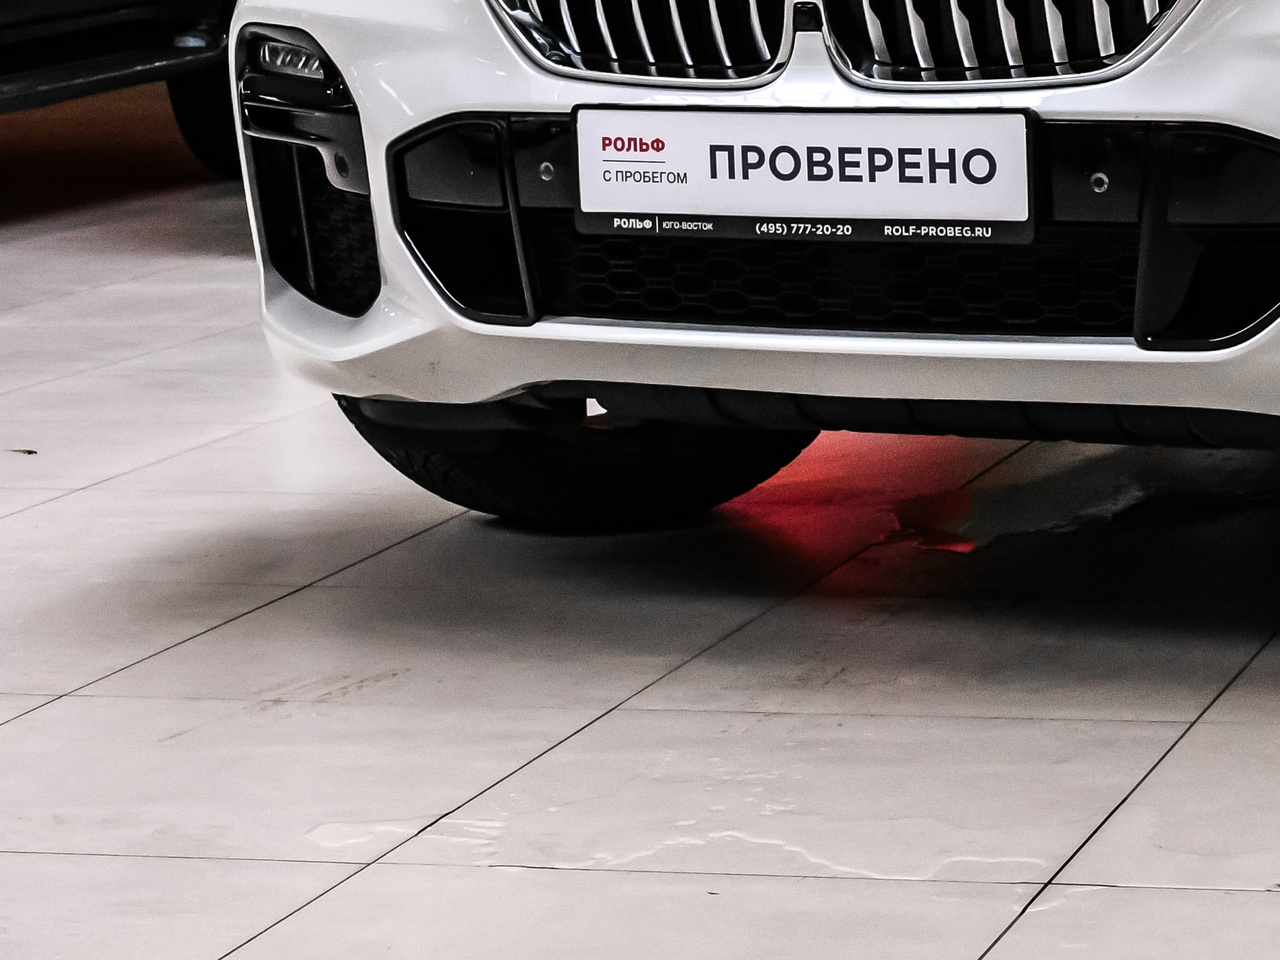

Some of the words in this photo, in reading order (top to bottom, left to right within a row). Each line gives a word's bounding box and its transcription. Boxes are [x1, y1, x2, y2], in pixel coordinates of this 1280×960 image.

[601, 136, 666, 153] РОЛЬФ
[709, 144, 998, 185] ПРОВЕРЕНО
[602, 170, 612, 182] С
[615, 170, 688, 184] ПРОБЕГОМ
[613, 217, 653, 230] РОЛЬФ
[662, 220, 714, 231] ЮГО-ВОСТОК
[755, 222, 788, 236] (495)
[790, 223, 852, 236] 777-20-20
[884, 225, 992, 238] ROLF-PROBEG.RU
